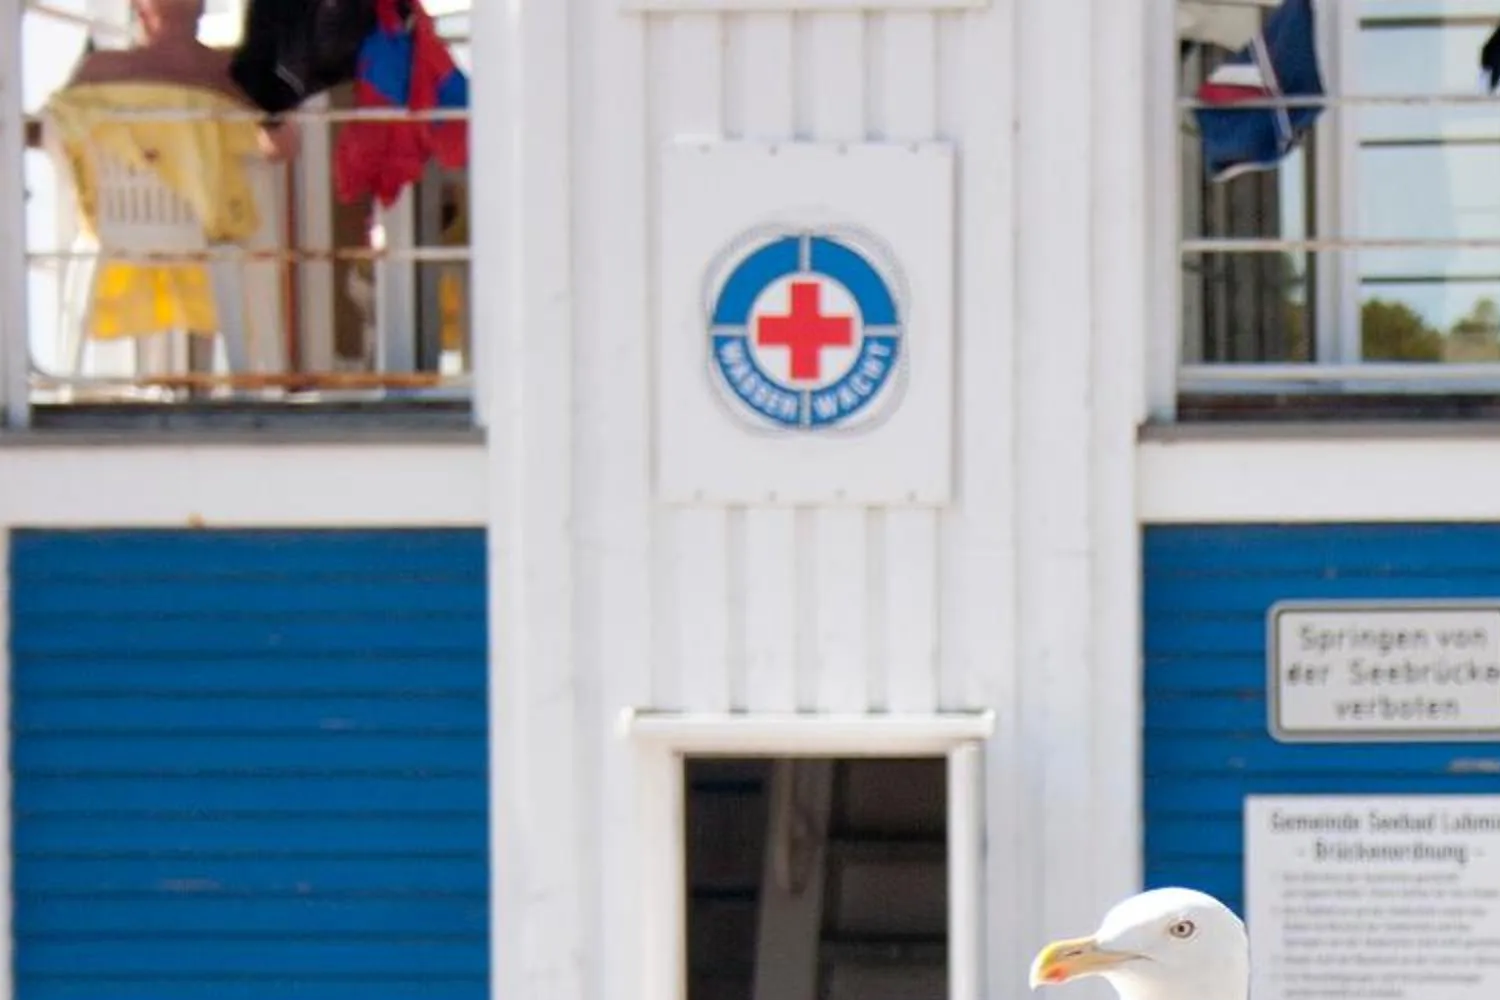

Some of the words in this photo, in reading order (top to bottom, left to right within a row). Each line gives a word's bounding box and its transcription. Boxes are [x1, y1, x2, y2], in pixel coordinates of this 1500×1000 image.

[719, 340, 799, 421] WASSER
[813, 340, 893, 420] WACHT
[1298, 623, 1429, 656] Springen
[1435, 628, 1488, 649] von
[1287, 661, 1329, 686] der
[1348, 658, 1500, 686] Seebrücke
[1334, 695, 1459, 720] verboten
[1270, 809, 1360, 833] Gemeinde
[1367, 809, 1435, 833] Seebad
[1314, 838, 1469, 866] Brückenordnung
